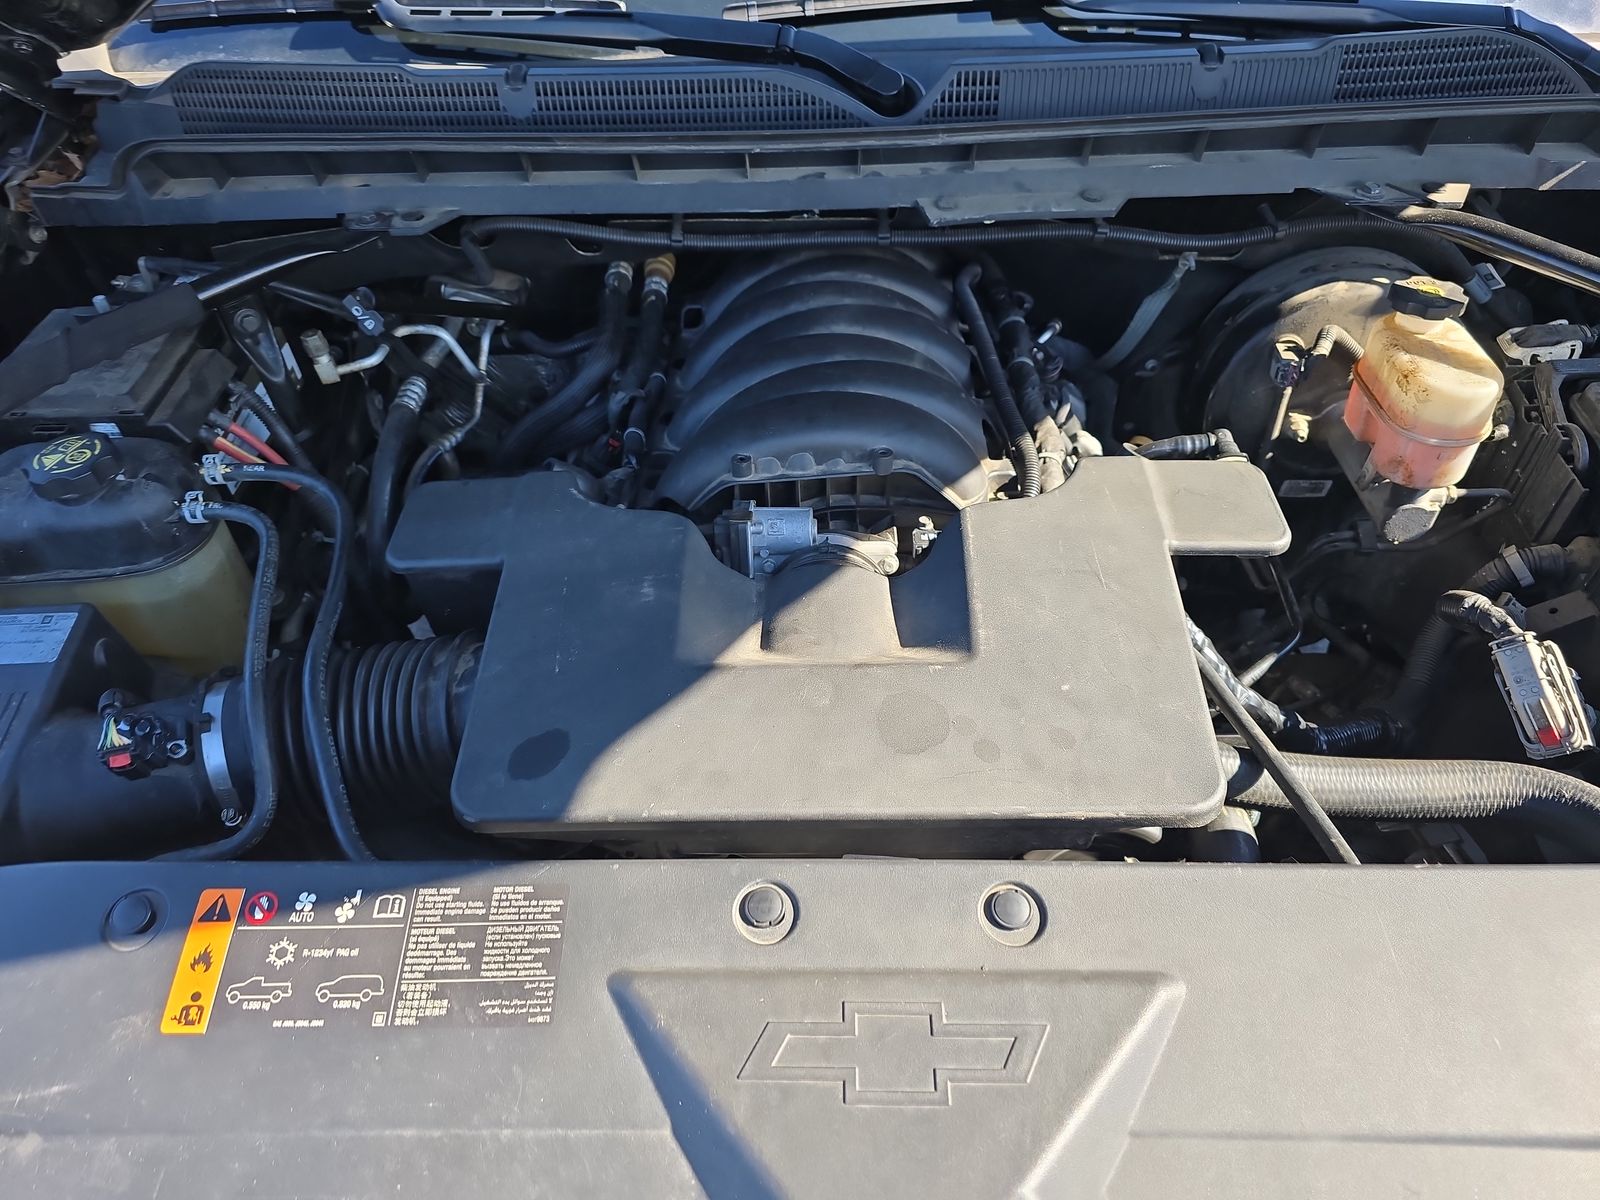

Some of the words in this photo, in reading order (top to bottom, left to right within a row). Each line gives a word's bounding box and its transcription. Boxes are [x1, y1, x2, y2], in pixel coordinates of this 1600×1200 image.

[289, 912, 314, 922] AUTO
[525, 925, 559, 934] ДВИГАТЕЛЬ
[302, 948, 334, 958] R-1234yf
[336, 948, 350, 956] PAG
[262, 1001, 270, 1011] kg
[352, 1000, 360, 1010] kg
